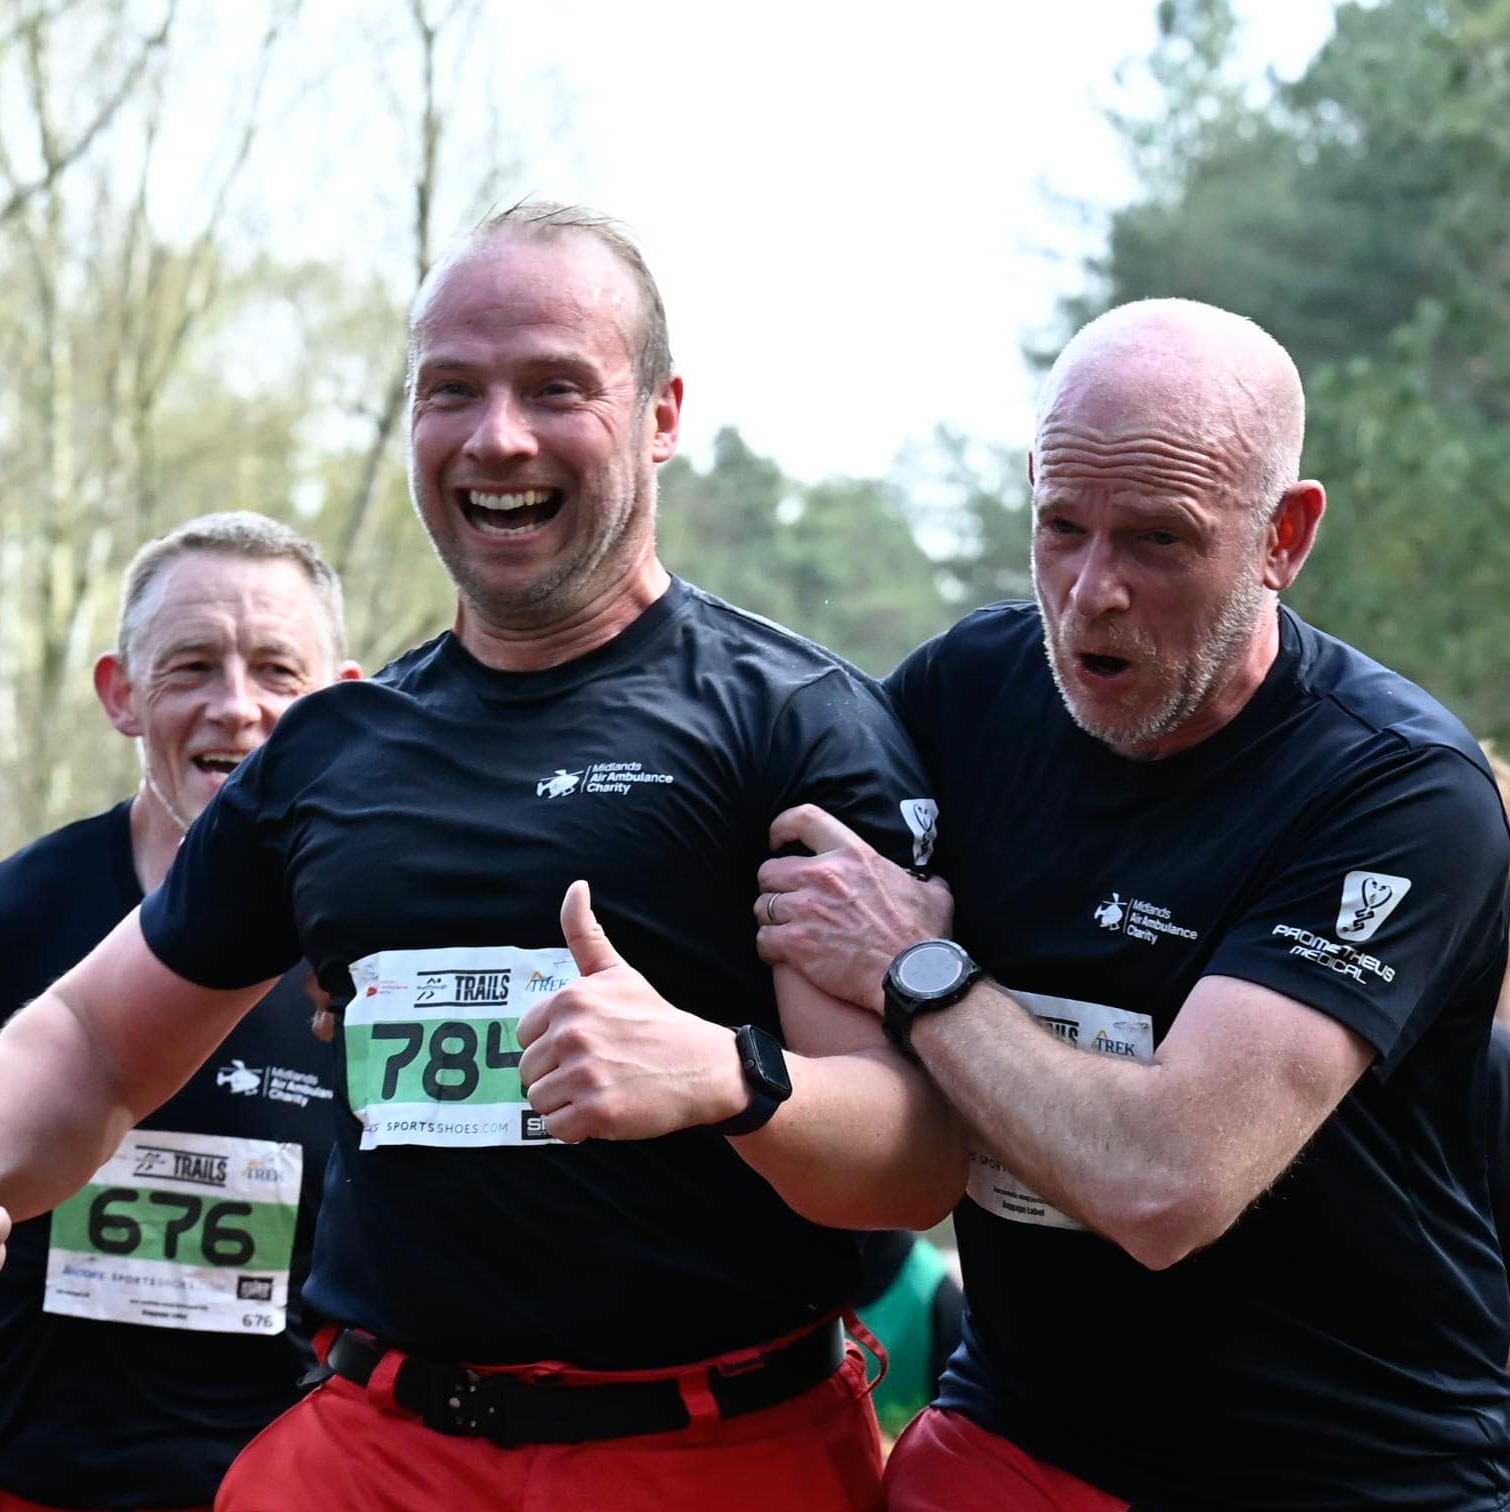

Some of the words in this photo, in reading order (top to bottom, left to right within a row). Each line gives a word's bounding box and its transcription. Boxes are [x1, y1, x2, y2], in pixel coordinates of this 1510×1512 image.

[590, 773, 606, 783] Air
[607, 771, 675, 784] Ambulance
[592, 761, 642, 772] Midlands
[586, 783, 632, 796] Charity
[1132, 899, 1172, 920] Midlands
[1126, 924, 1159, 946] Charity
[1129, 912, 1143, 925] Air
[1141, 915, 1199, 940] Ambulance
[1272, 924, 1396, 983] PROMETHEUS
[1289, 945, 1367, 985] MEDICAL
[454, 974, 511, 1001] TRAILS
[1095, 1036, 1135, 1057] TREK
[173, 1154, 227, 1183] TRAILS
[86, 1188, 256, 1267] 676
[241, 1313, 274, 1329] 676
